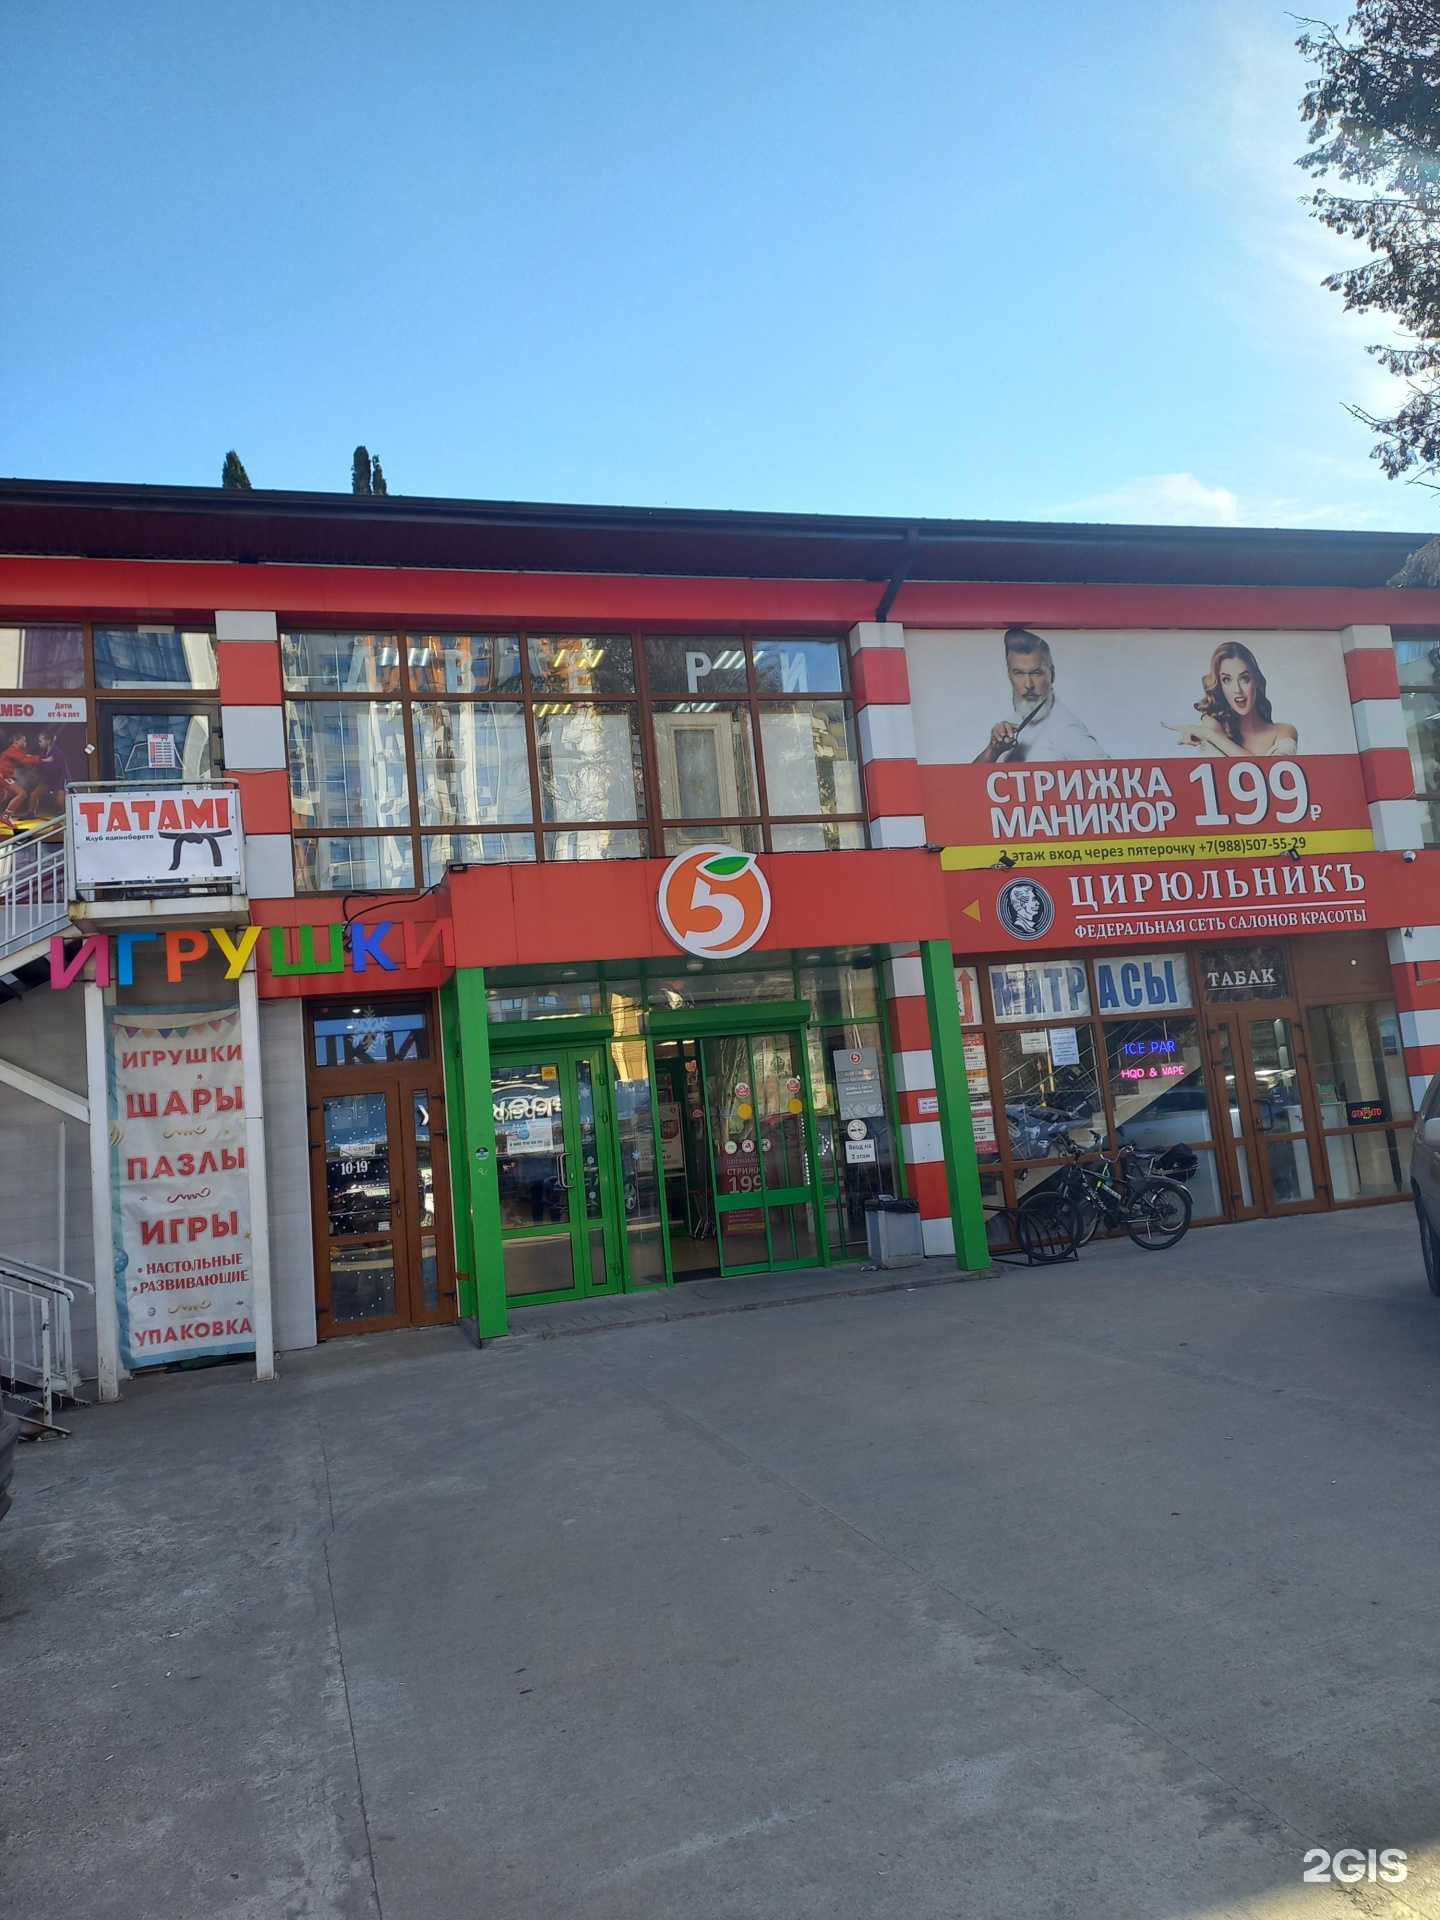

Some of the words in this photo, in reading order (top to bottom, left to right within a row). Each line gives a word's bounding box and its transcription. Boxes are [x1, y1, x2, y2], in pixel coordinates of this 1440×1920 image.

[0, 703, 34, 717] МБО
[986, 767, 1171, 803] СТРИЖКА
[79, 798, 229, 833] TATAMI
[990, 801, 1176, 839] МАНИКЮР
[1011, 850, 1045, 862] этаж
[1050, 849, 1081, 861] вход
[1085, 846, 1124, 860] через
[1128, 842, 1196, 858] пятерочку
[1199, 836, 1307, 854] +7(988)507-55-29
[1068, 863, 1365, 912] ЦИРЮЛЬНИКЪ
[1074, 919, 1185, 939] ФЕДЕРАЛЬНАЯ
[1189, 917, 1226, 932] СЕТЬ
[1229, 912, 1298, 929] САЛОНОВ
[1301, 909, 1367, 925] КРАСОТЫ
[50, 920, 457, 990] ИГРУШКИ
[1207, 968, 1277, 987] ТАБАК
[122, 1044, 242, 1069] ИГРУШКИ
[1124, 1042, 1145, 1056] ICE
[1120, 1069, 1145, 1079] HQD
[1162, 1064, 1185, 1076] VAPE
[127, 1086, 244, 1119] ШАРЫ
[127, 1147, 246, 1181] ПАЗЛЫ
[141, 1211, 238, 1246] ИГРЫ
[146, 1253, 243, 1275] НАСТОЛЬНЫЕ
[140, 1270, 250, 1294] РАЗВИВАЮЩИЕ
[134, 1317, 253, 1346] УПАКОВКА
